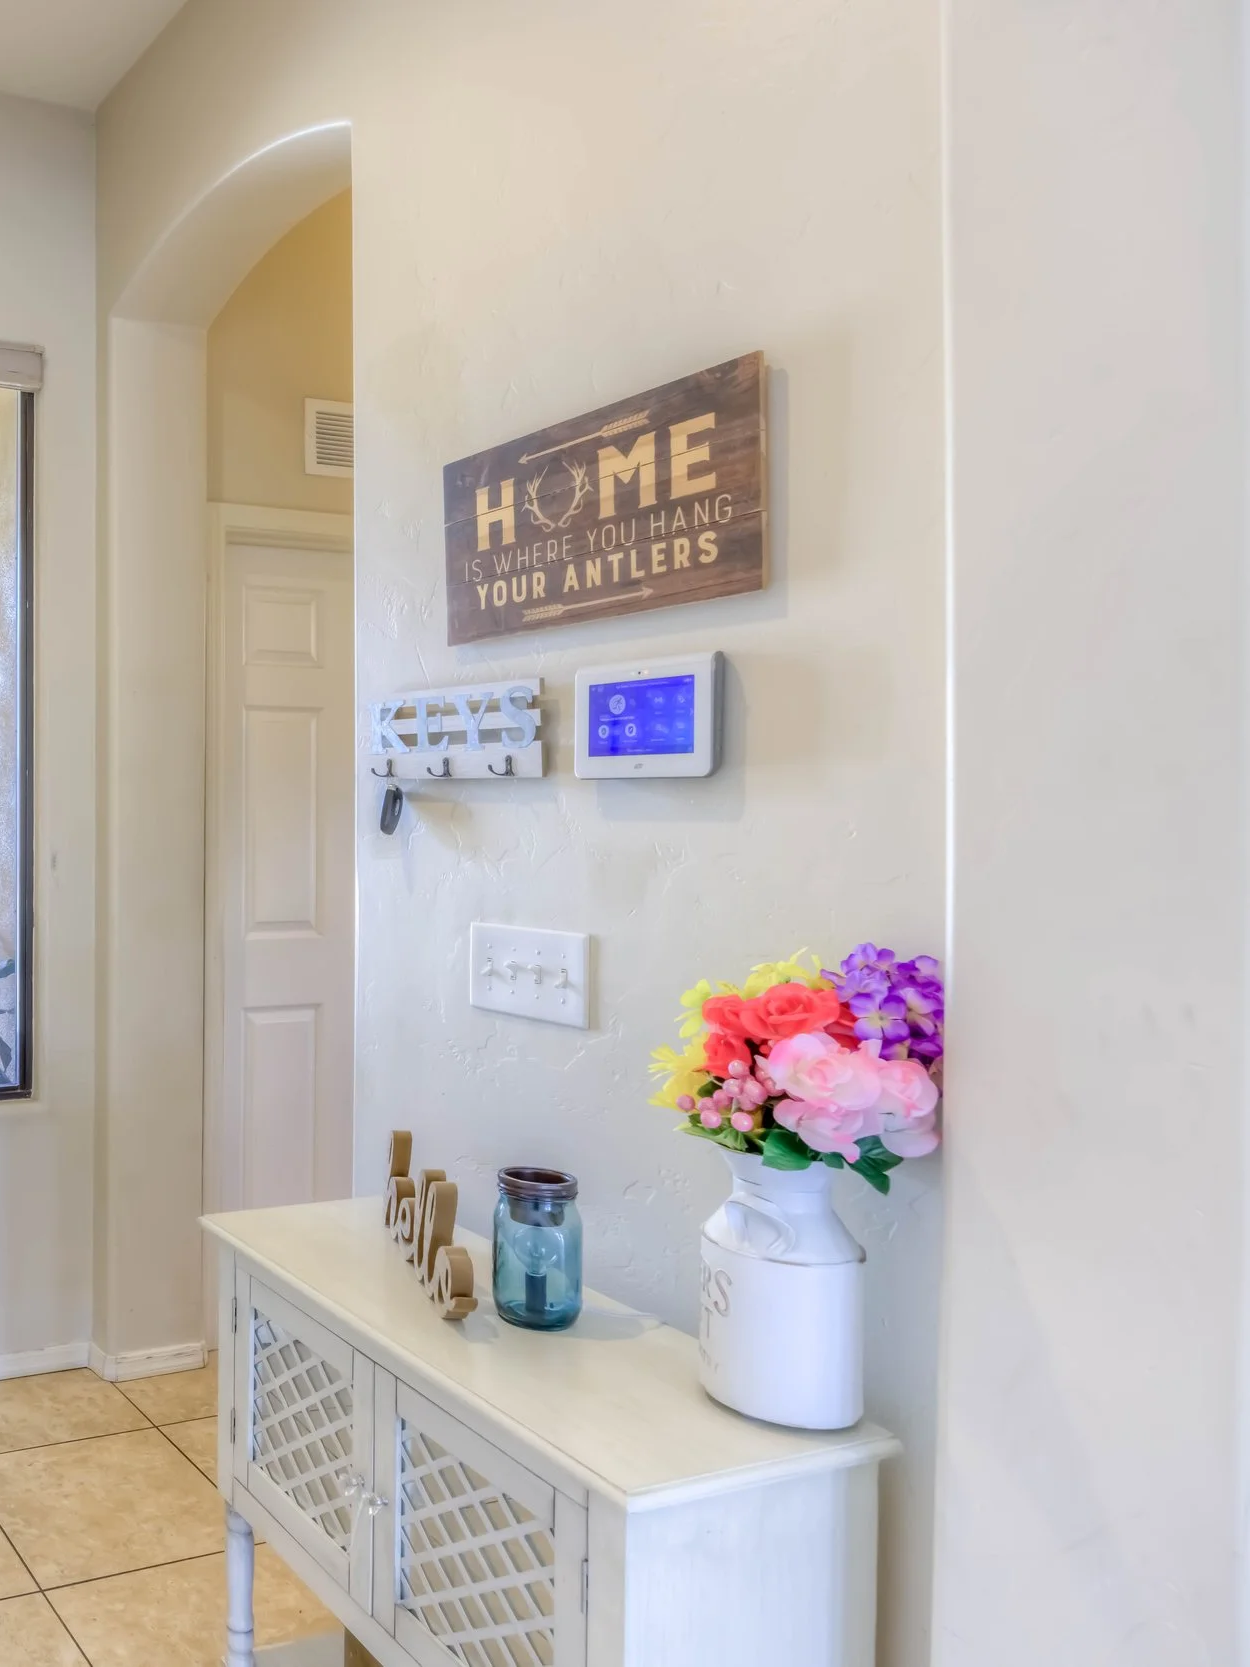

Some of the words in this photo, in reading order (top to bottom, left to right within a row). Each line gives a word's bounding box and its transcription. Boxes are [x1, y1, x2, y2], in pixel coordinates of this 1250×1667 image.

[465, 559, 483, 582] IS
[494, 535, 573, 575] WHERE
[586, 520, 636, 551] YOU
[650, 494, 733, 538] HANG
[476, 571, 546, 610] YOUR
[563, 531, 719, 593] ANTLERS
[367, 686, 537, 754] KEYS
